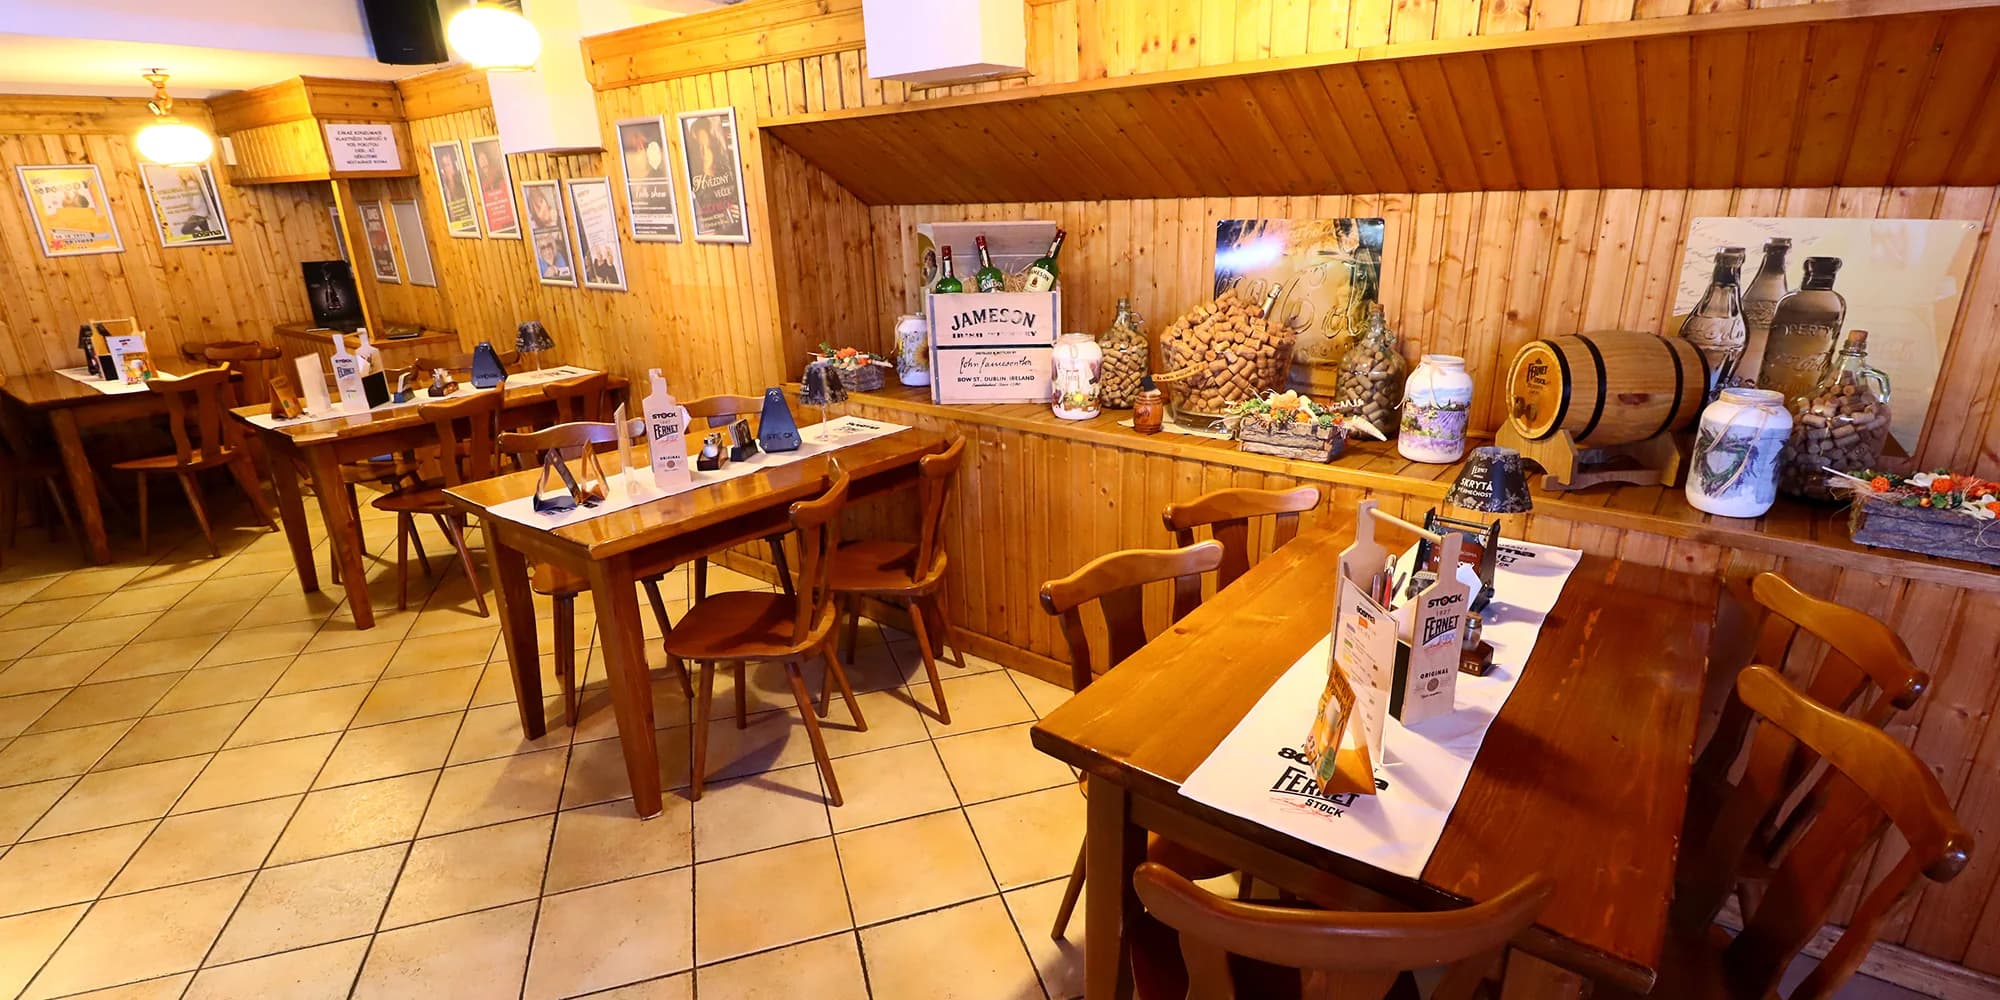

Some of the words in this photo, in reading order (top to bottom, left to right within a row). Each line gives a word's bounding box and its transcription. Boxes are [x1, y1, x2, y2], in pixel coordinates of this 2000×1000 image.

[951, 308, 1036, 331] JAMESON
[652, 412, 677, 420] STOCK
[653, 423, 679, 441] FERNET
[1459, 477, 1494, 492] SKRYTÁ
[1427, 594, 1463, 609] STOCK
[1422, 615, 1460, 647] FERNET
[1420, 668, 1449, 680] ORIGINAL
[1304, 798, 1345, 818] STOCK
